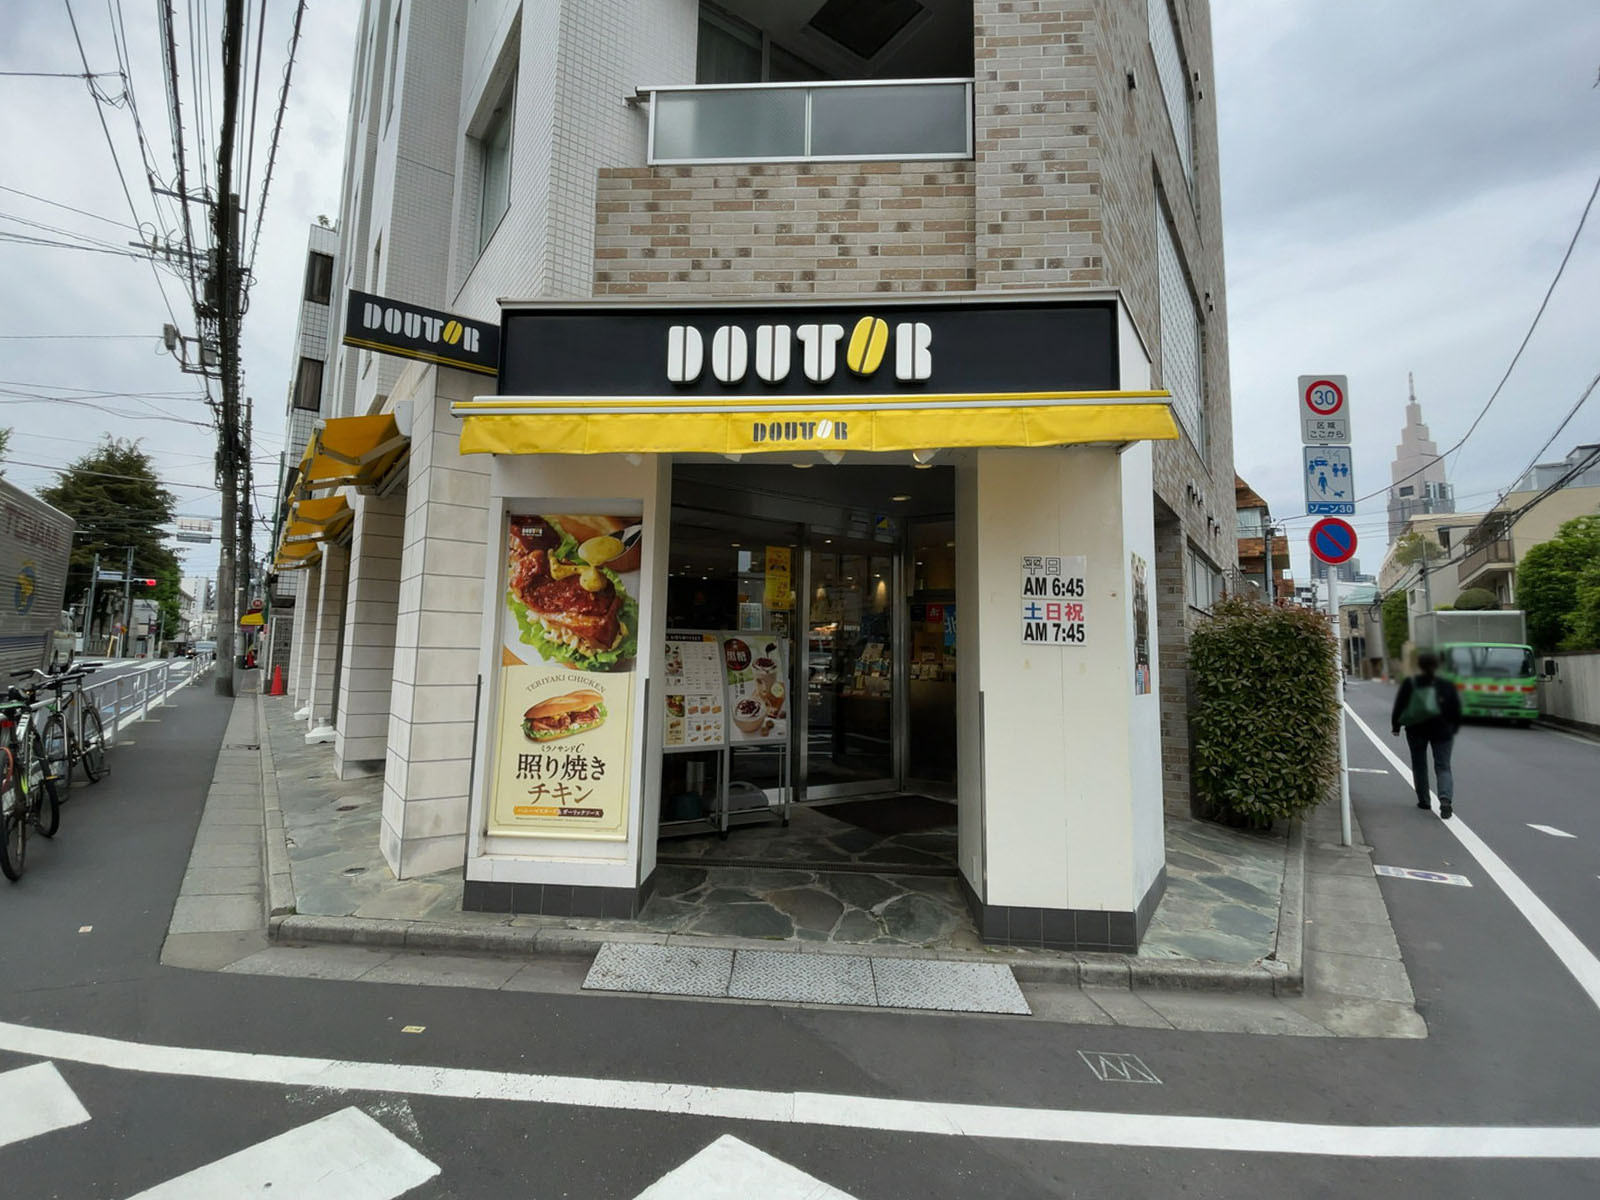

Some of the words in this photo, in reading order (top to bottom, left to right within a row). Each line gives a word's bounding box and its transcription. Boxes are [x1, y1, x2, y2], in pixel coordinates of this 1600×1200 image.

[362, 301, 480, 353] DOUTOR
[667, 315, 933, 383] DOUTOR
[1313, 390, 1336, 406] 30
[752, 418, 848, 442] DOUTOR
[1310, 430, 1344, 439] ここから
[1316, 421, 1336, 430] 区域
[1309, 504, 1353, 513] ゾーン30
[1023, 556, 1062, 576] 平日
[1023, 577, 1047, 596] AM
[1052, 578, 1085, 597] 6:45
[1023, 602, 1085, 622] 土日祝
[1023, 622, 1048, 641] AM
[1052, 623, 1085, 642] 7:45
[525, 674, 566, 693] TERIYAKI
[567, 674, 607, 694] CHICKEN
[516, 753, 606, 781] 照り焼き
[527, 782, 594, 806] チキン
